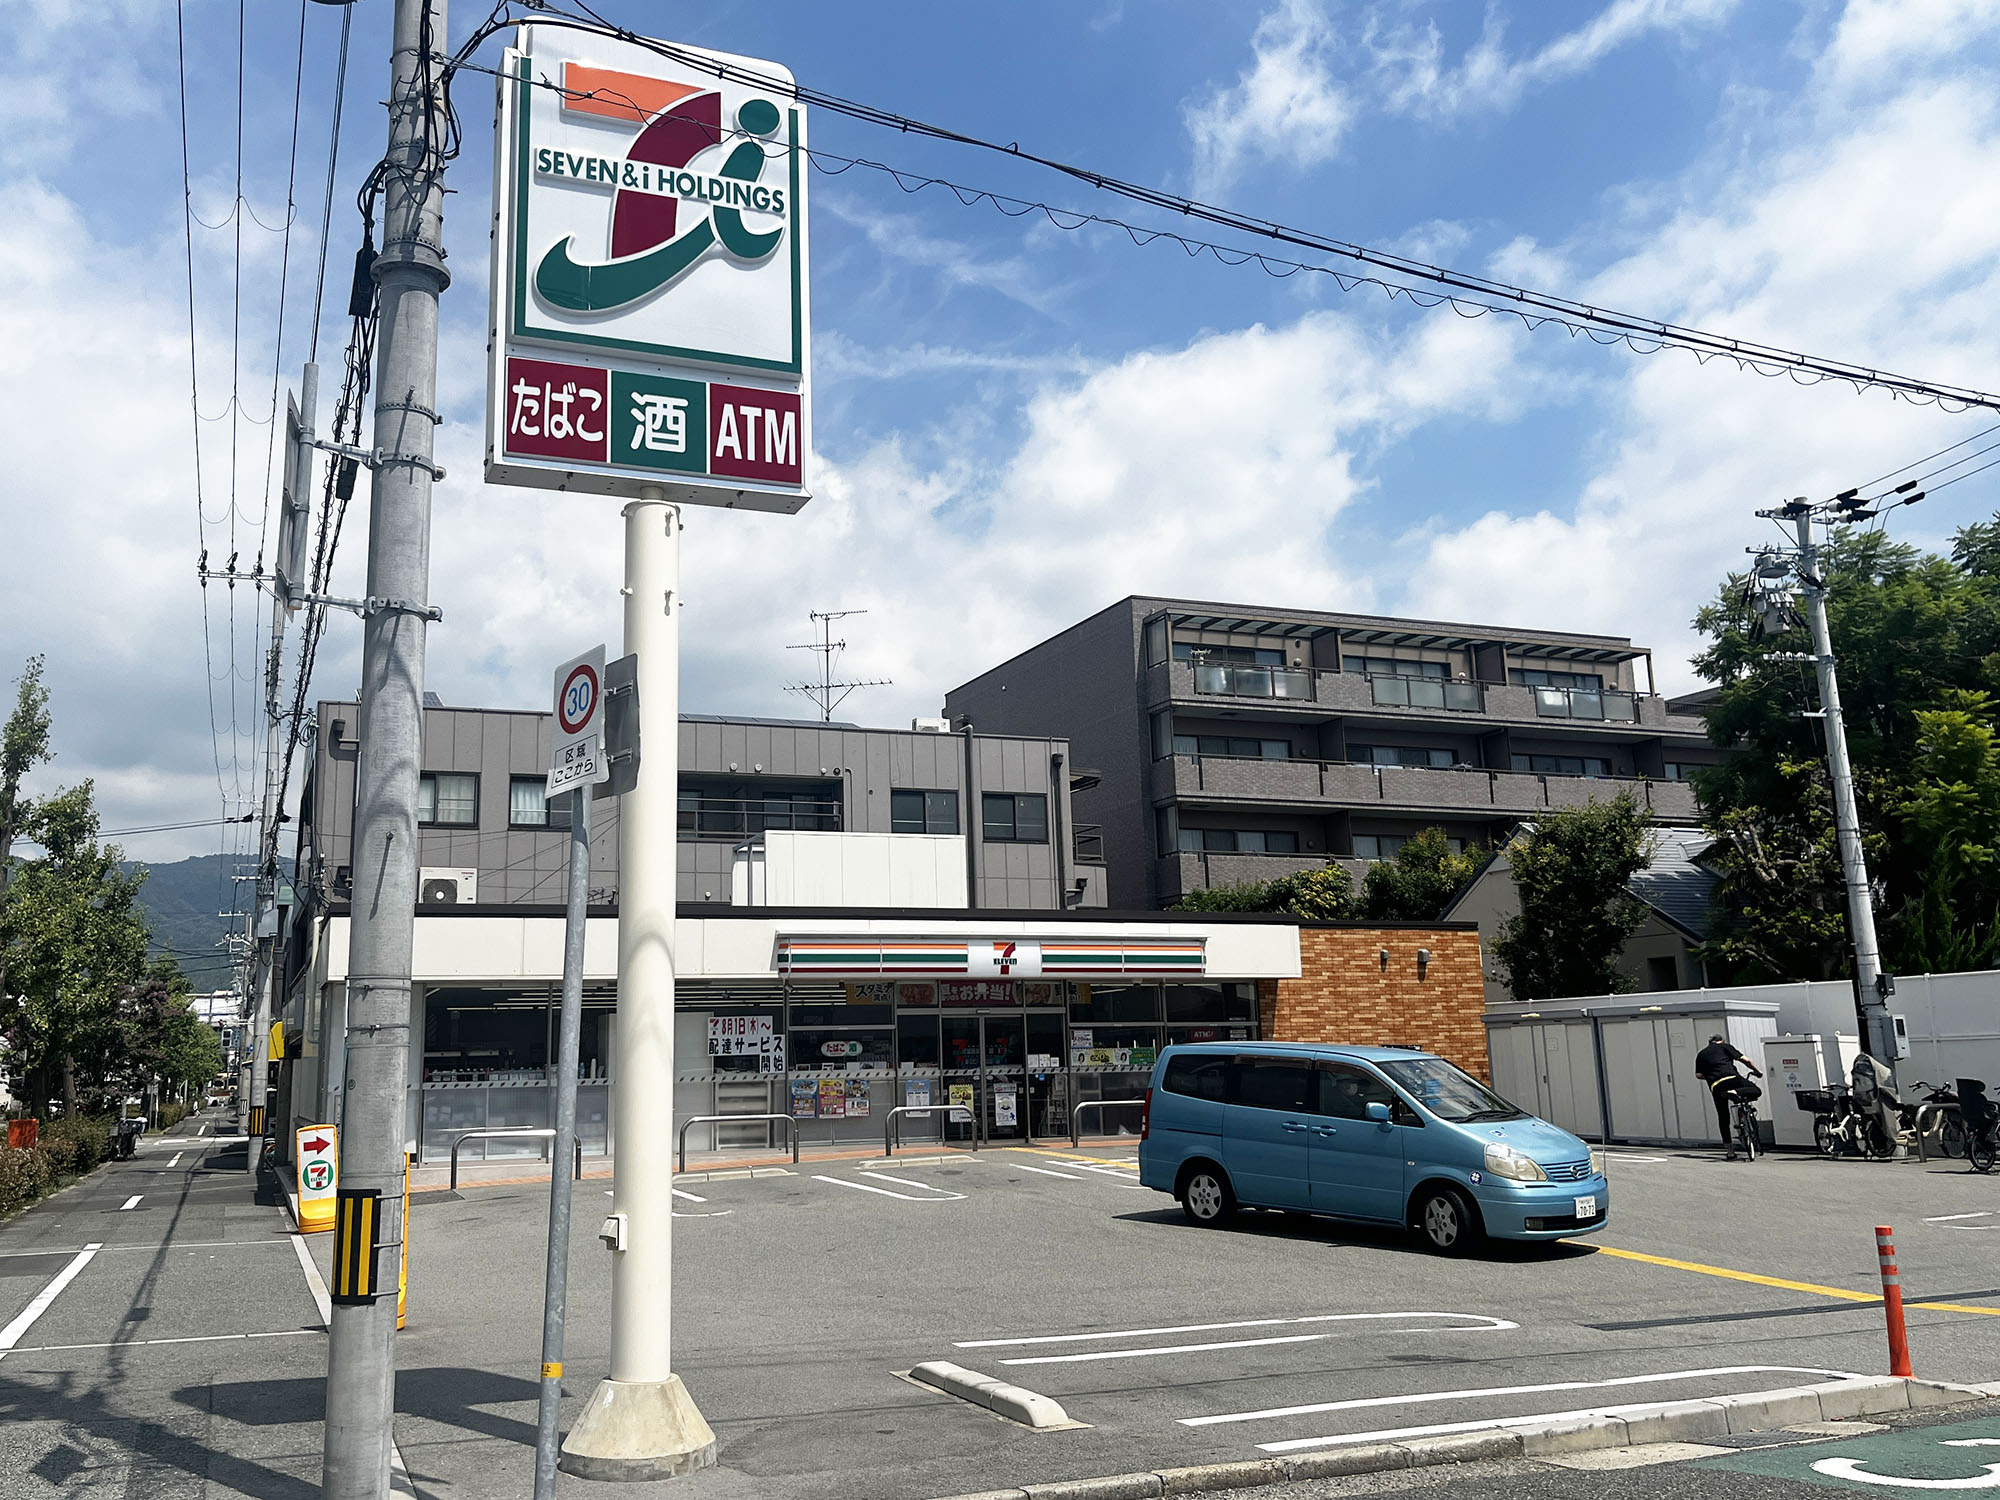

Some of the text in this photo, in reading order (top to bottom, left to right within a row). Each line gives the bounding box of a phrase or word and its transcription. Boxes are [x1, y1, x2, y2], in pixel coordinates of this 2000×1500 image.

[657, 168, 785, 213] HOLDINGS
[511, 376, 604, 442] たばこ
[630, 391, 689, 454] 酒
[715, 403, 797, 467] ATM
[568, 682, 589, 716] 30
[565, 743, 586, 764] 区域
[554, 758, 594, 784] ここから
[708, 1035, 783, 1055] 配達サービス
[826, 1043, 846, 1053] たばこ
[760, 1055, 784, 1073] 開始
